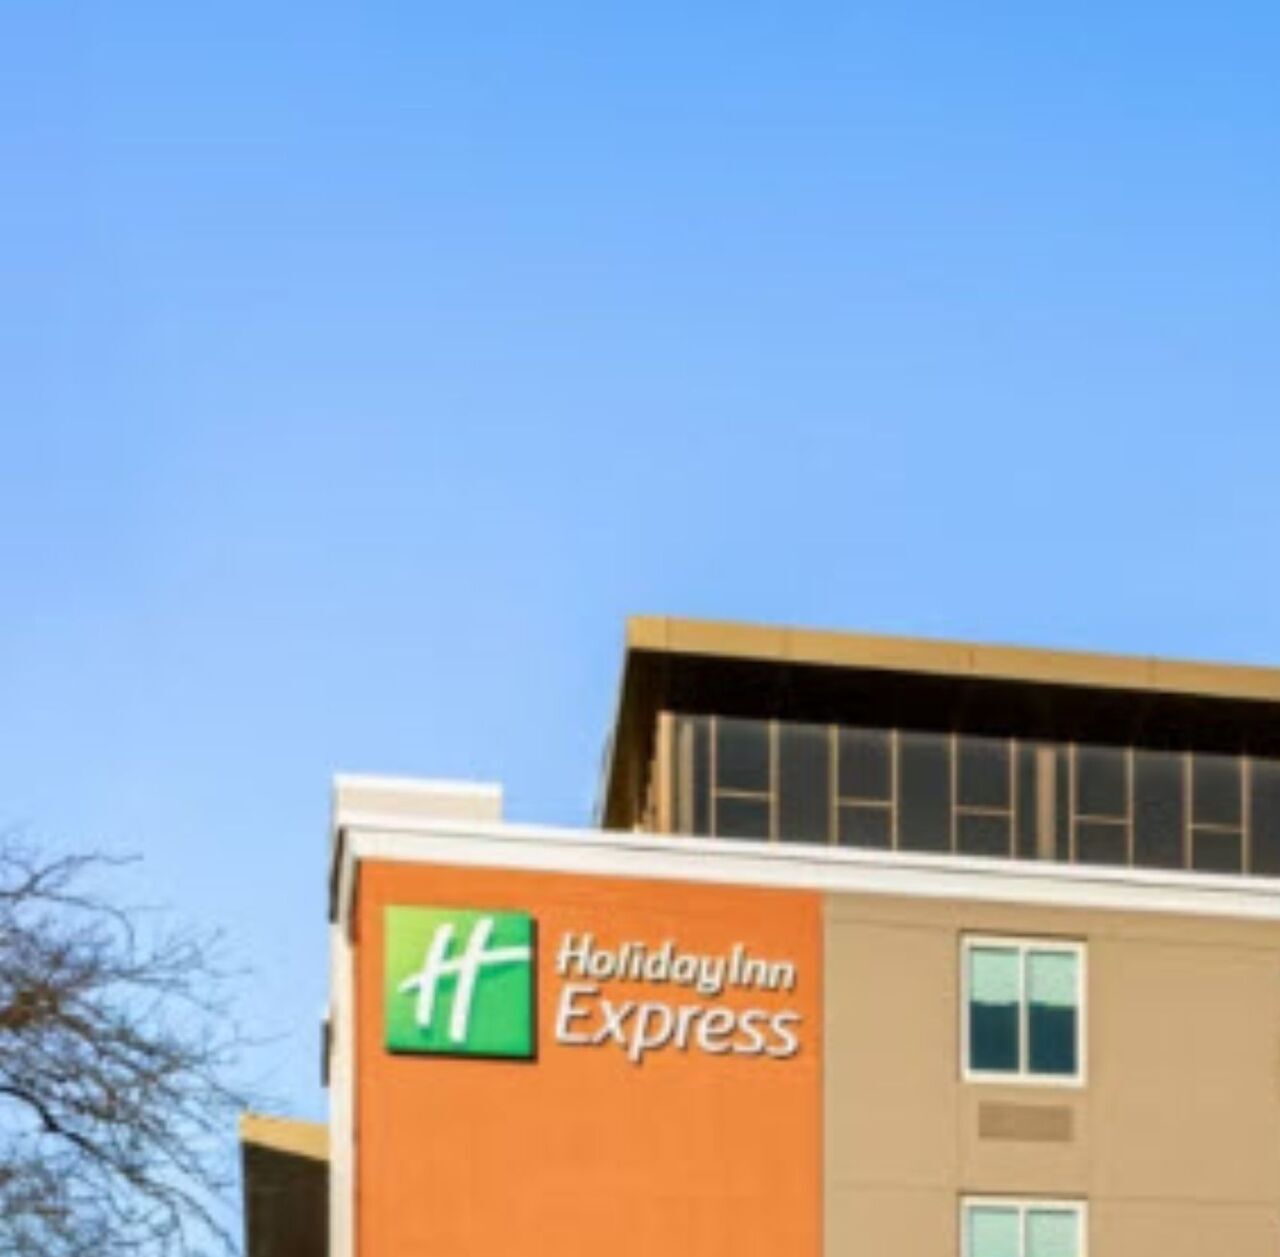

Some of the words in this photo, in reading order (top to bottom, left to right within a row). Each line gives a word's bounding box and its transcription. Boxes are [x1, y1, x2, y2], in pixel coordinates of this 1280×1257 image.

[556, 933, 724, 995] Holiday
[728, 942, 797, 988] Inn
[555, 983, 801, 1062] Express
